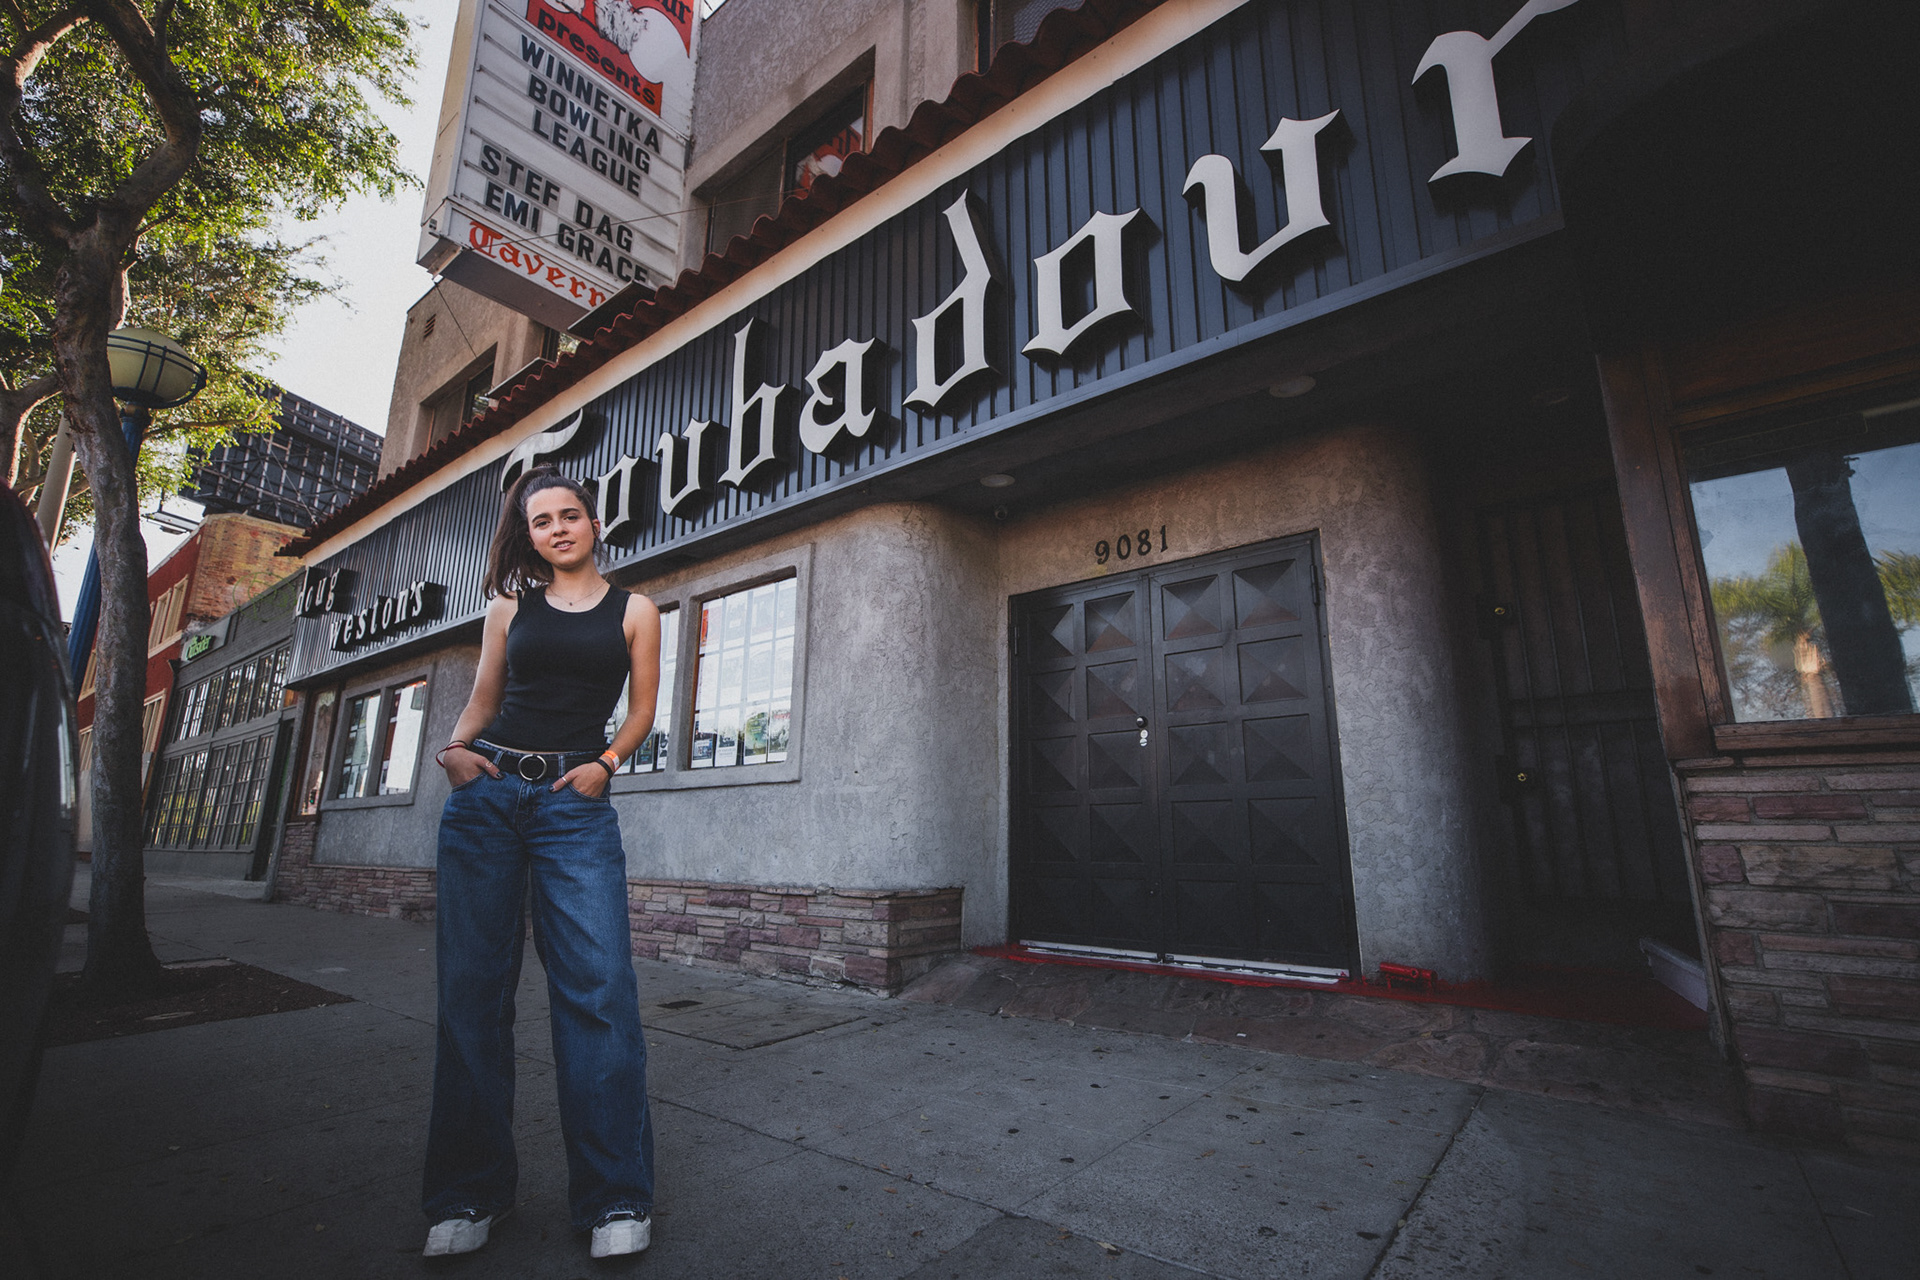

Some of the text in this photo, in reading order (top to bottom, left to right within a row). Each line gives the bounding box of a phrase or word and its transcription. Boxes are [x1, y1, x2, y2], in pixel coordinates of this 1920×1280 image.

[521, 34, 661, 154] WINNETKA
[537, 7, 657, 106] presents
[528, 74, 651, 175] BOWLING
[533, 109, 641, 197] LEAGUE
[481, 144, 634, 253] STEF DAG
[485, 181, 541, 233] EMI
[469, 220, 607, 308] Tavern
[501, 0, 1579, 542] Toubadour
[1095, 524, 1169, 565] 9081
[296, 566, 341, 617] doug
